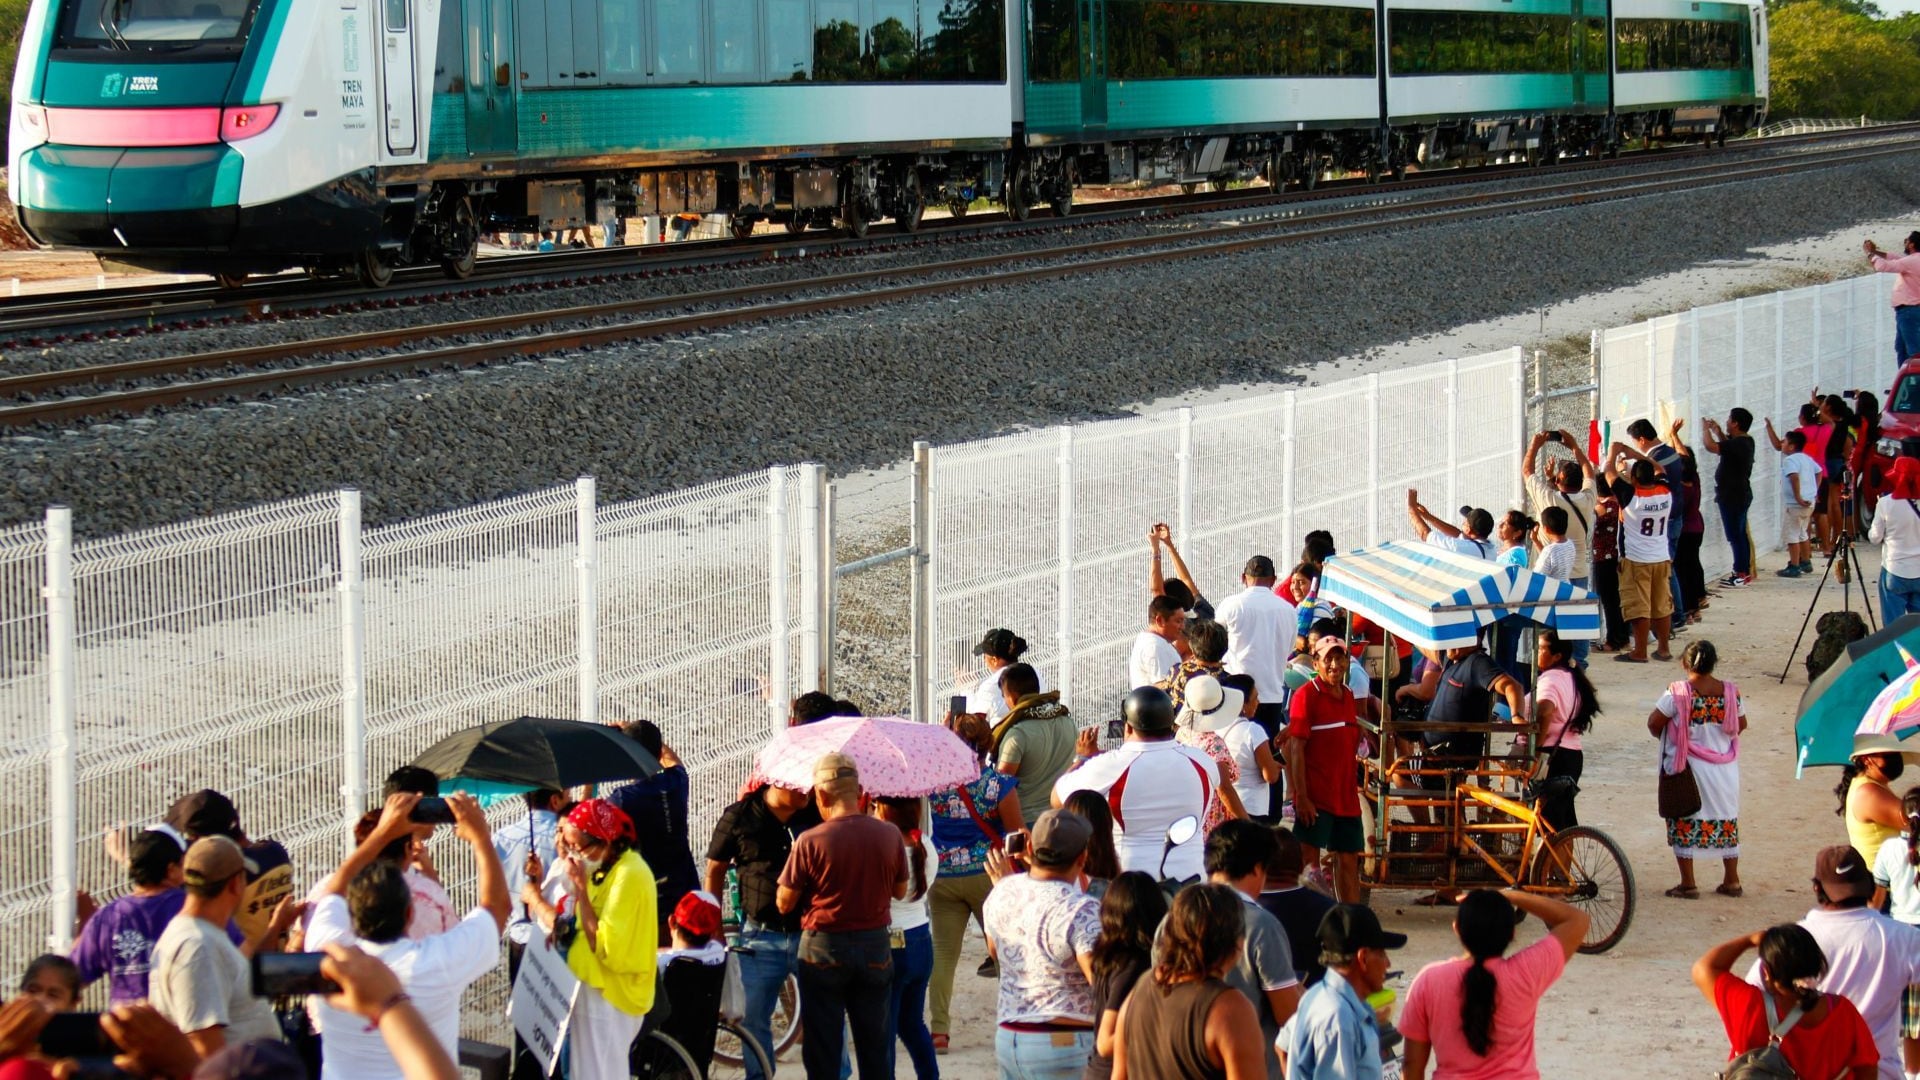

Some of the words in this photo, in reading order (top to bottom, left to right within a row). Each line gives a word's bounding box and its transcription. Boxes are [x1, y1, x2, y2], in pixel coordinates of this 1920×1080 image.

[132, 76, 158, 84] TREN
[342, 80, 362, 93] TREN
[130, 83, 159, 91] MAYA
[342, 95, 364, 108] MAYA
[1640, 516, 1665, 537] 81
